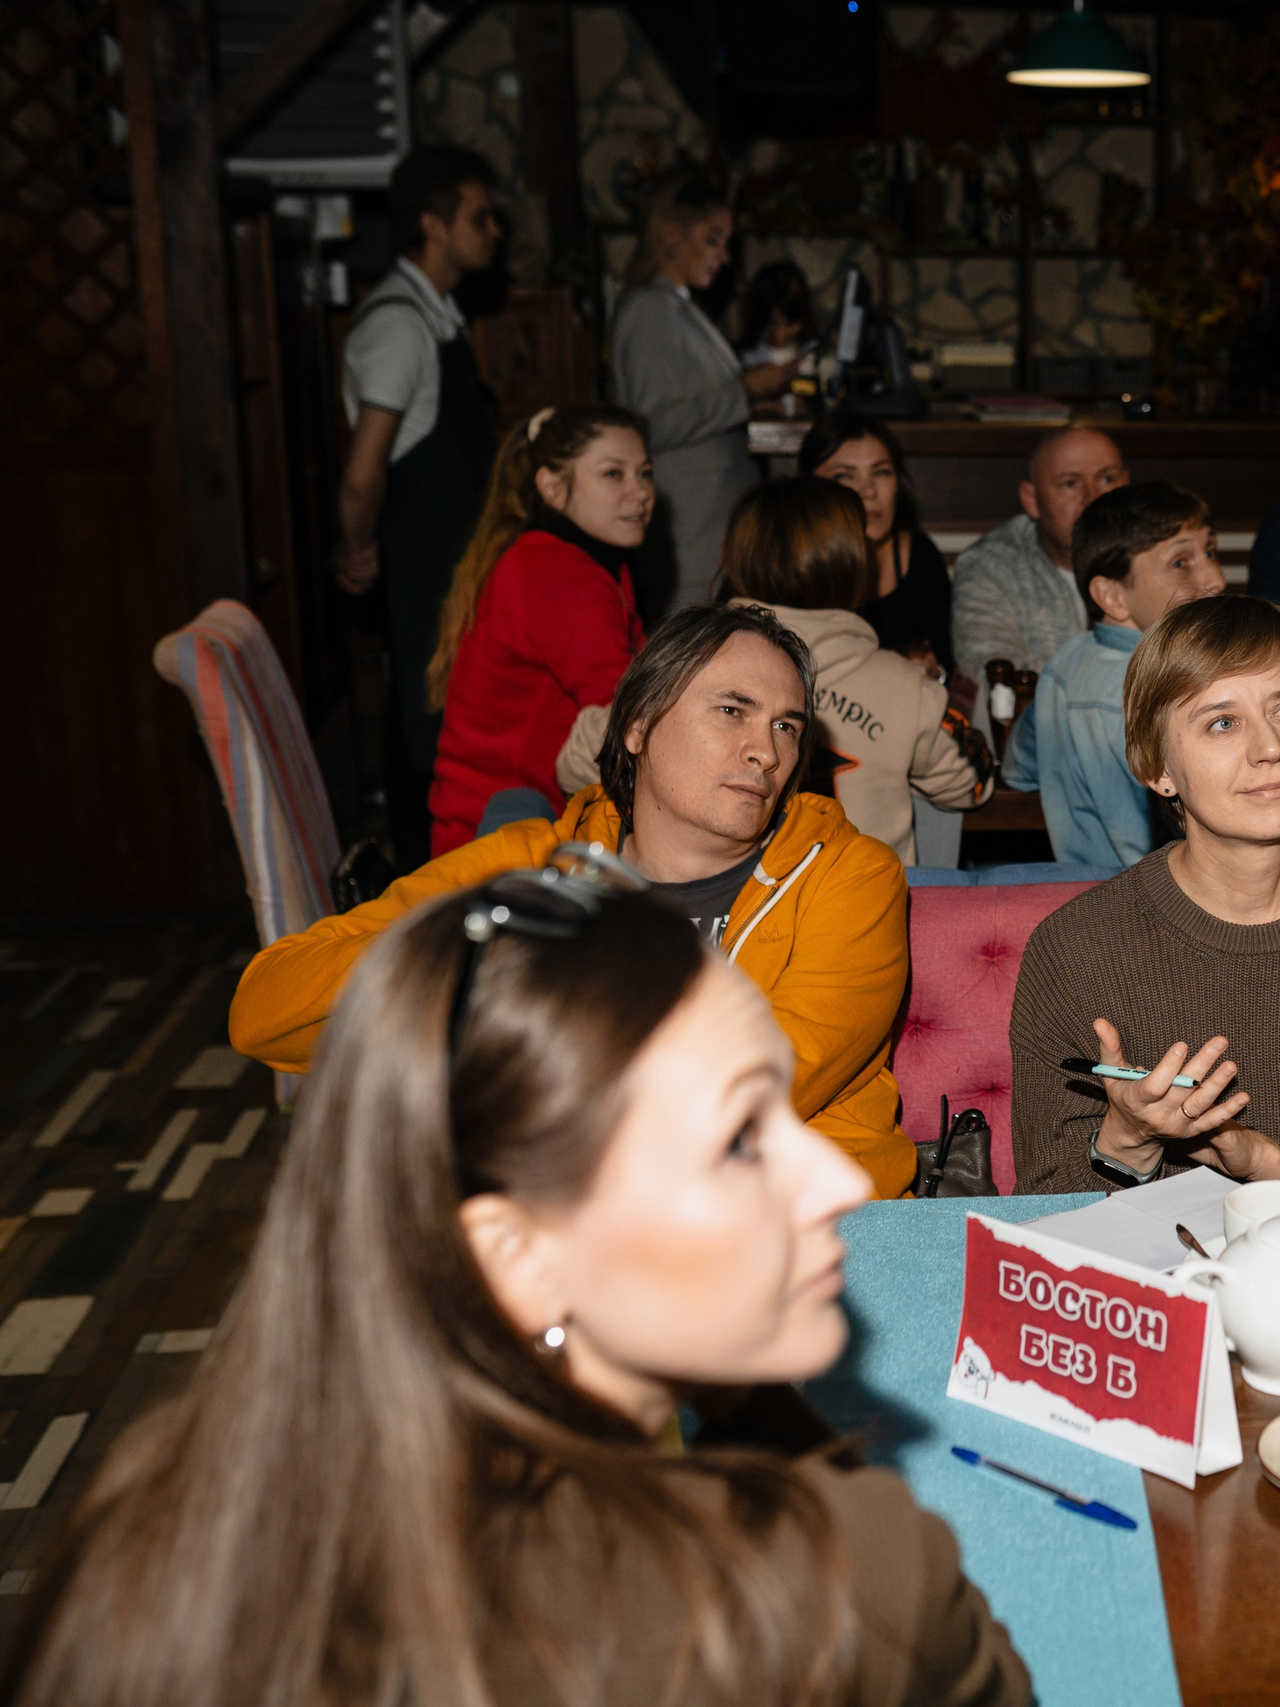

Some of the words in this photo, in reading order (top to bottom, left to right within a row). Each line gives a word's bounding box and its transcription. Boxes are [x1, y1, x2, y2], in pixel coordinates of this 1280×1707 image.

[999, 1260, 1167, 1352] БОСТОН
[1019, 1324, 1097, 1384] БЕЗ
[1106, 1354, 1137, 1399] Б
